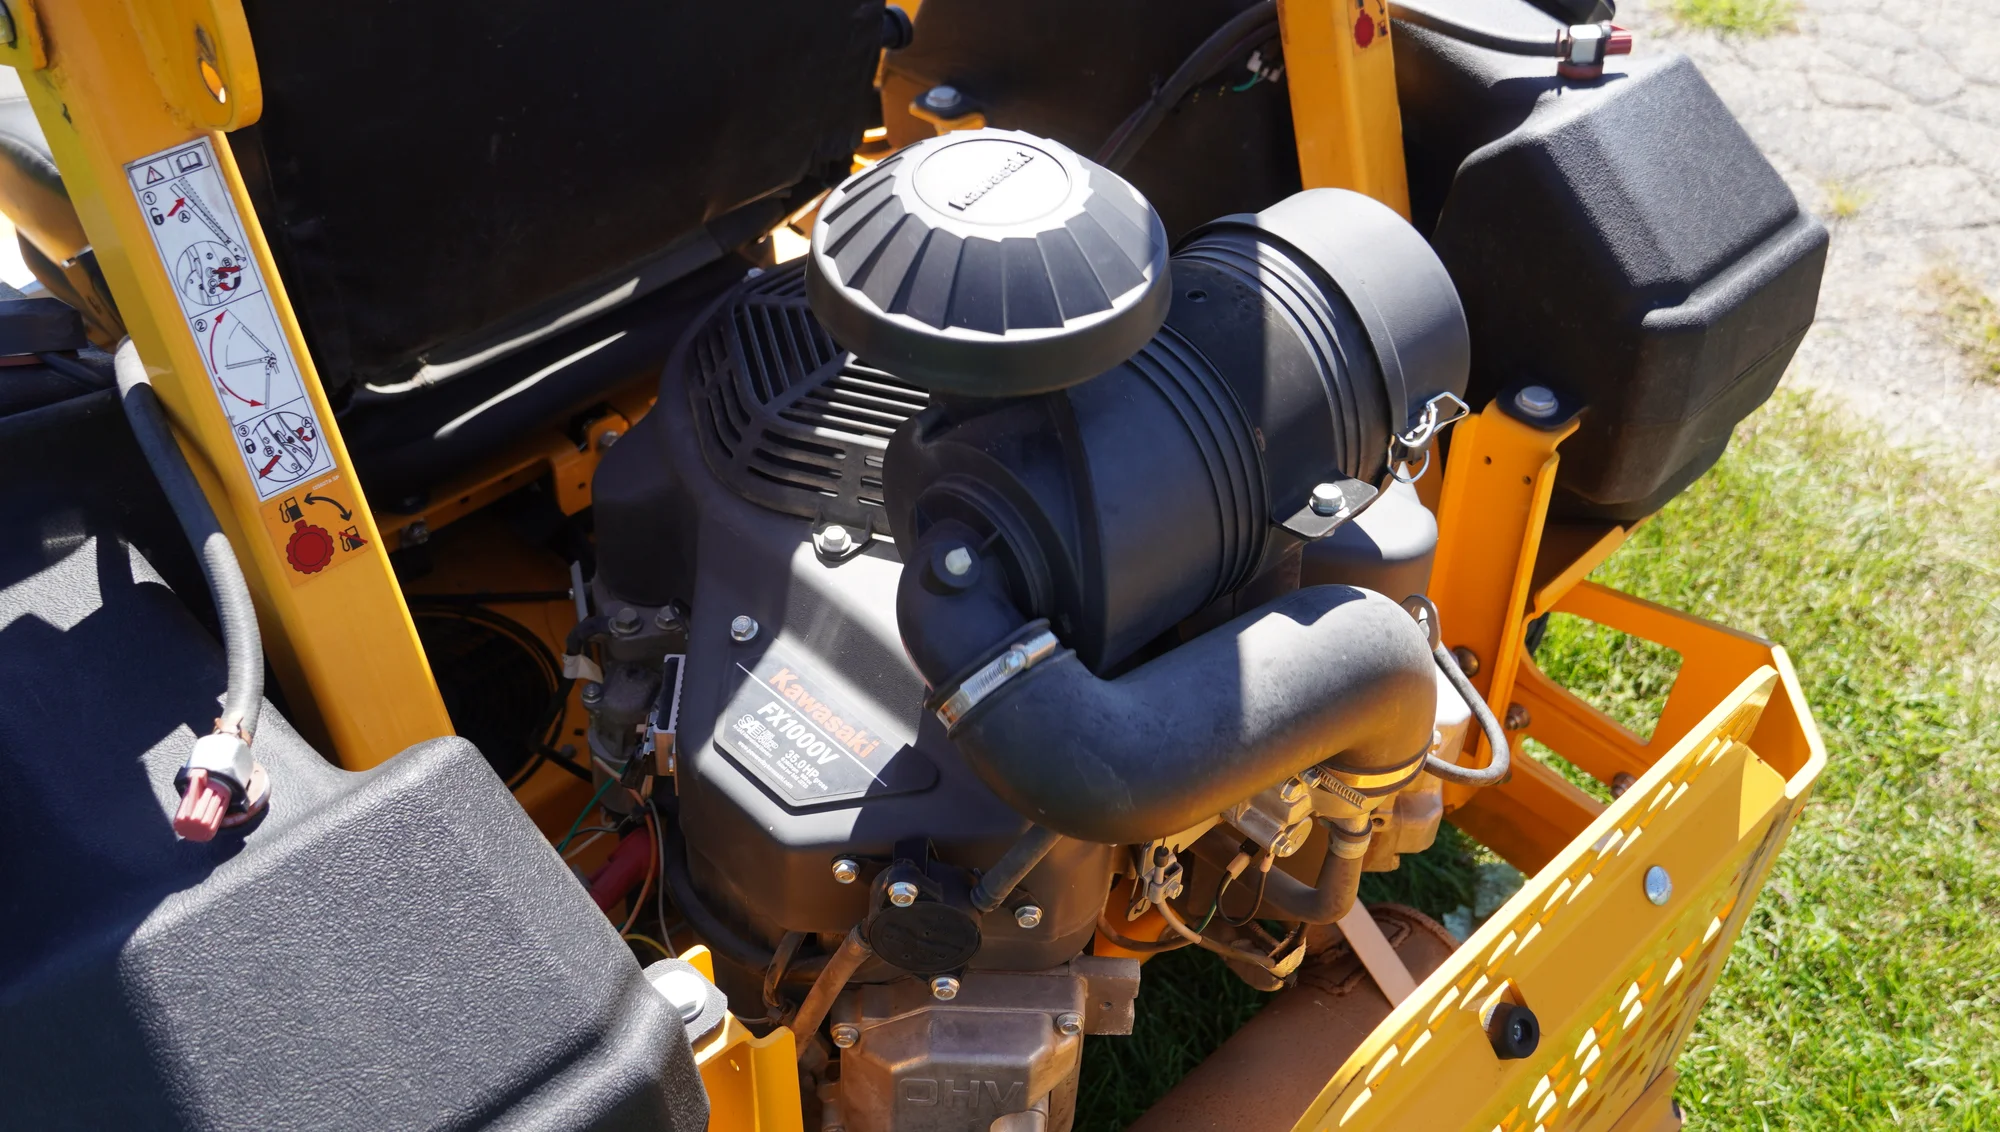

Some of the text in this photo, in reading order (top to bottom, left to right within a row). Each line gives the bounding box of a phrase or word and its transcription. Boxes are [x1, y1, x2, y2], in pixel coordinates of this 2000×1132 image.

[757, 701, 841, 765] FX1000V
[769, 667, 881, 758] Kawasaki
[900, 1078, 1024, 1108] OHV
